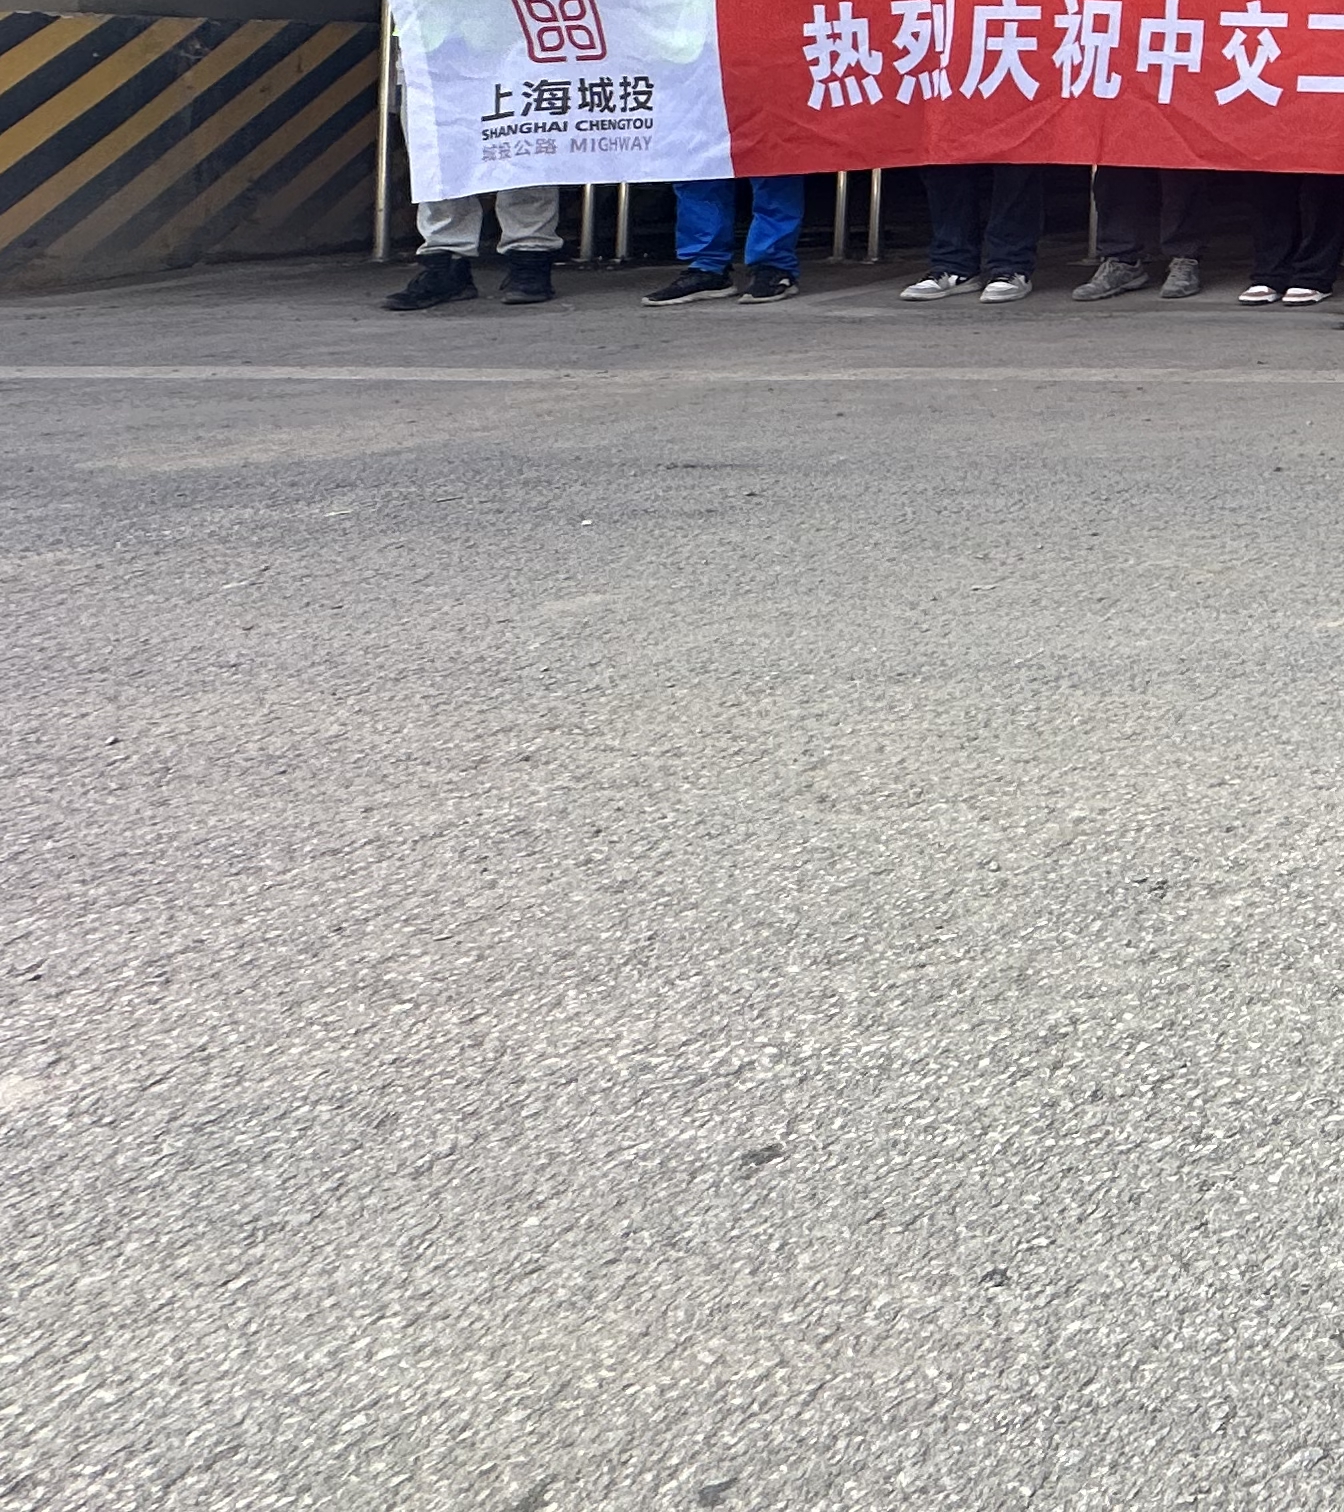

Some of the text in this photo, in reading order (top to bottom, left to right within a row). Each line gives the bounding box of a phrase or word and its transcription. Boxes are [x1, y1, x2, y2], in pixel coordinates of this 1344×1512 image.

[481, 75, 654, 122] 上海城投
[482, 118, 653, 140] SHANGHAI CHENGTOU
